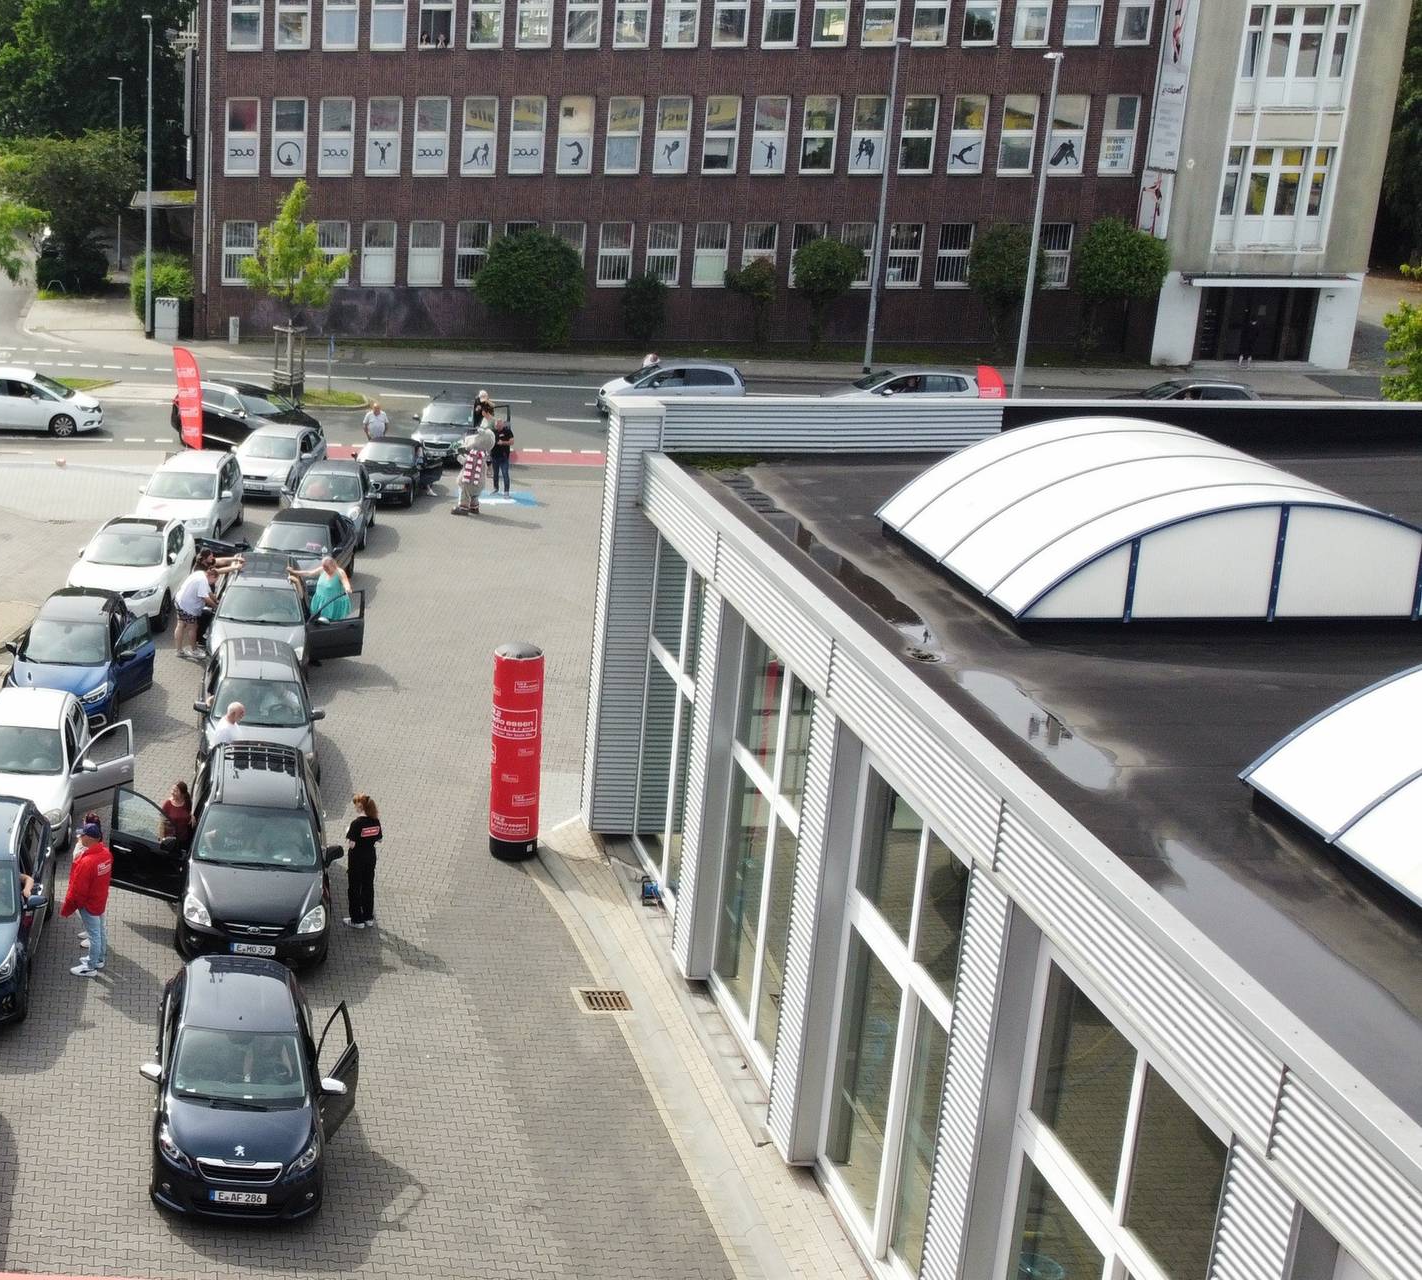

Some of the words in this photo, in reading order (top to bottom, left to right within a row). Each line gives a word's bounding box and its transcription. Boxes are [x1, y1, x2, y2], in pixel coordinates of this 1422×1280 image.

[237, 944, 243, 952] E
[219, 1191, 225, 1200] E
[245, 1194, 263, 1203] 286
